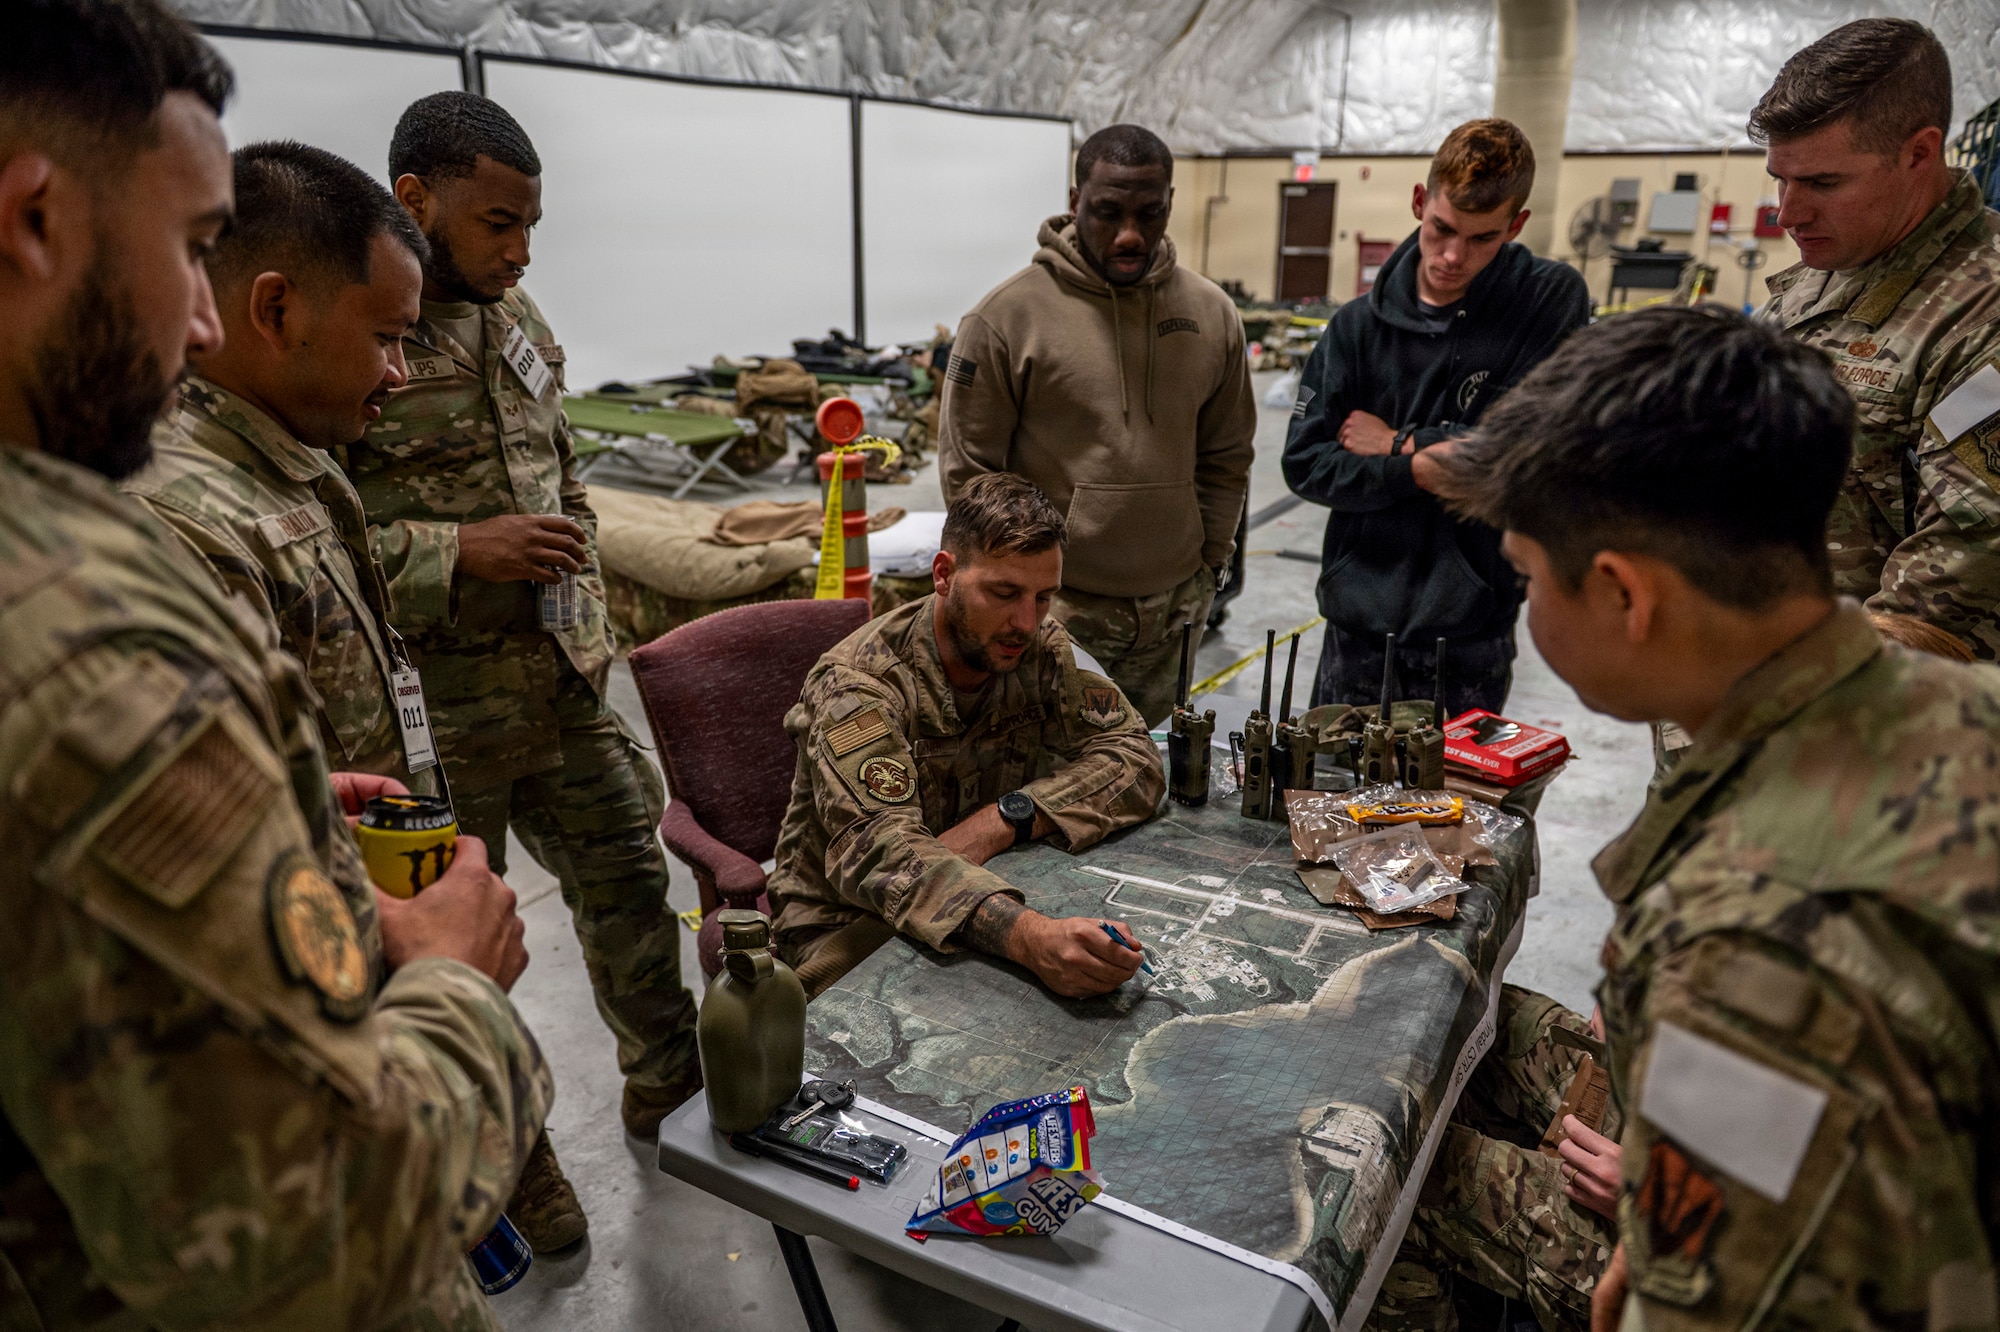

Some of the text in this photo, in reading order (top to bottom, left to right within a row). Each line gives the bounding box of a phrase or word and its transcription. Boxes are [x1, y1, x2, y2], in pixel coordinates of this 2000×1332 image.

[406, 360, 437, 378] LIPS
[518, 348, 536, 376] 010
[1847, 366, 1891, 388] FORCE
[397, 685, 421, 697] OBSERVER
[403, 705, 425, 730] 011
[1444, 745, 1500, 769] EST MEAL EVER
[1038, 1121, 1047, 1160] GUMMIES
